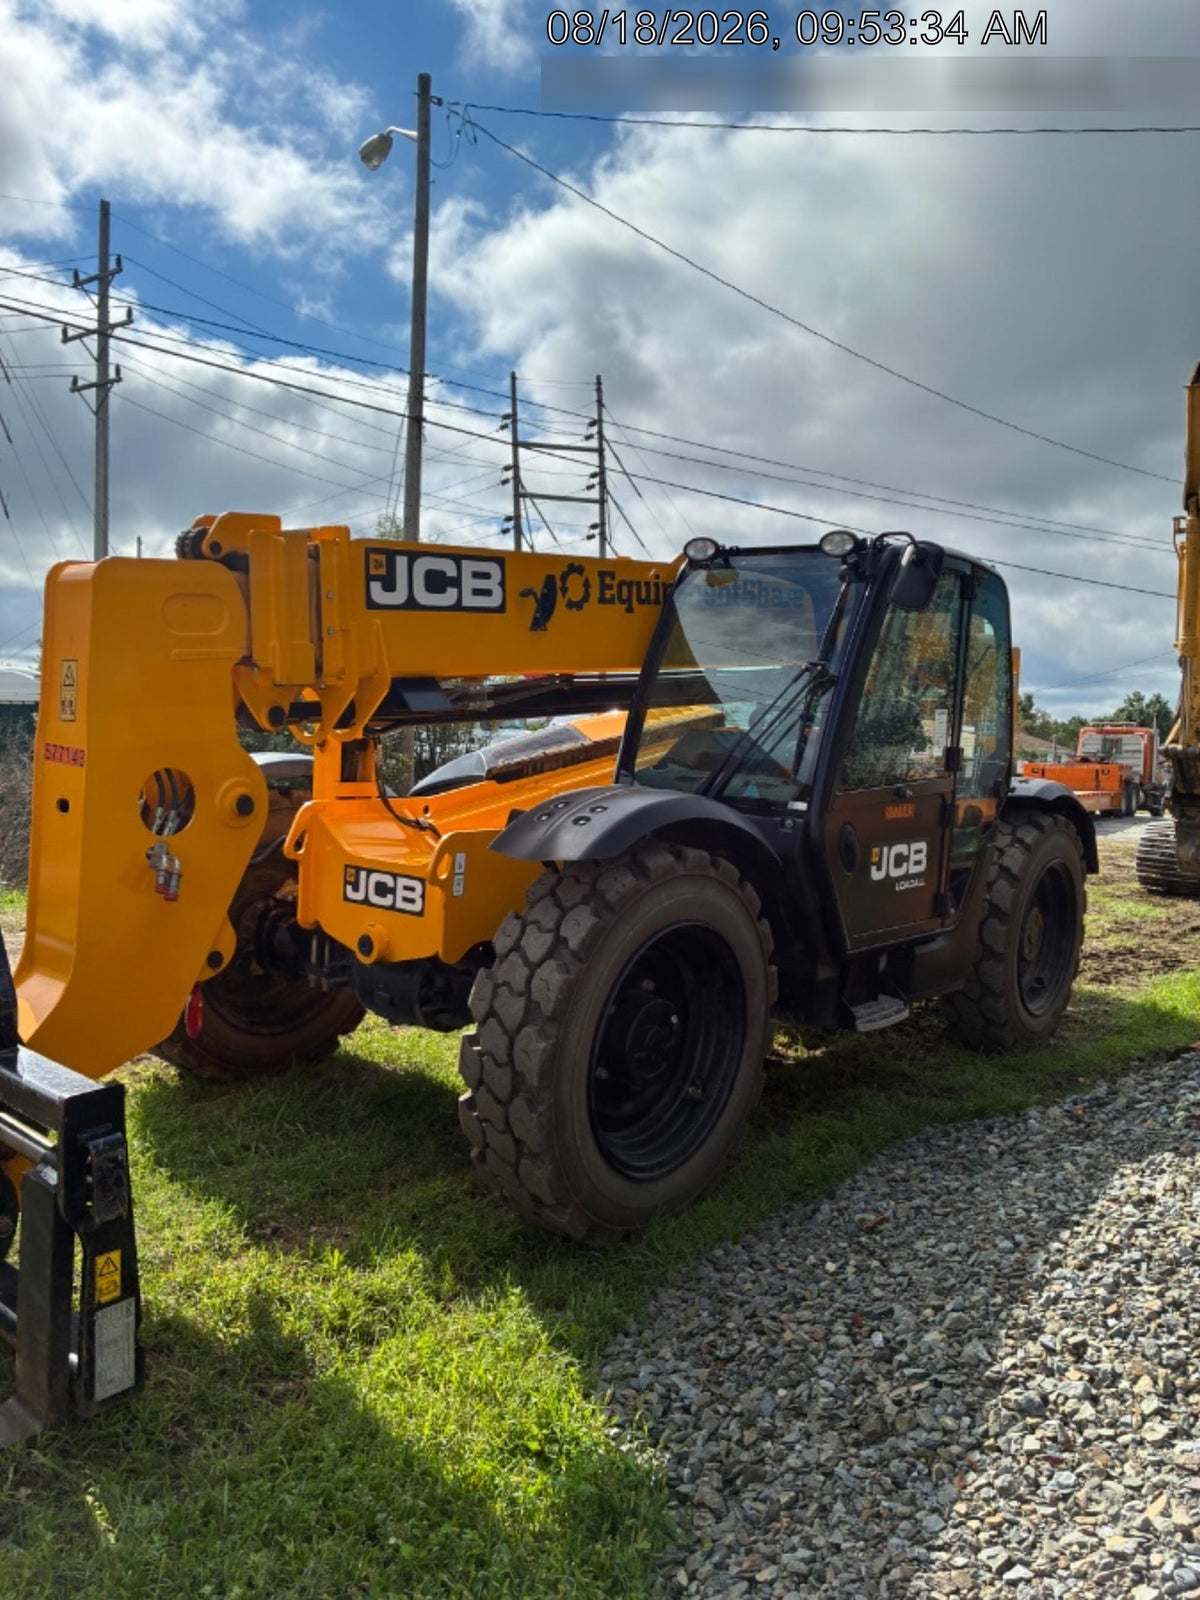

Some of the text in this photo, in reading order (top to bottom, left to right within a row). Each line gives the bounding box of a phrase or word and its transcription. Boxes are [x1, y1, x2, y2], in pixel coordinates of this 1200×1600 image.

[369, 554, 502, 607] JCB
[871, 841, 927, 881] JCB
[346, 870, 423, 913] JCB
